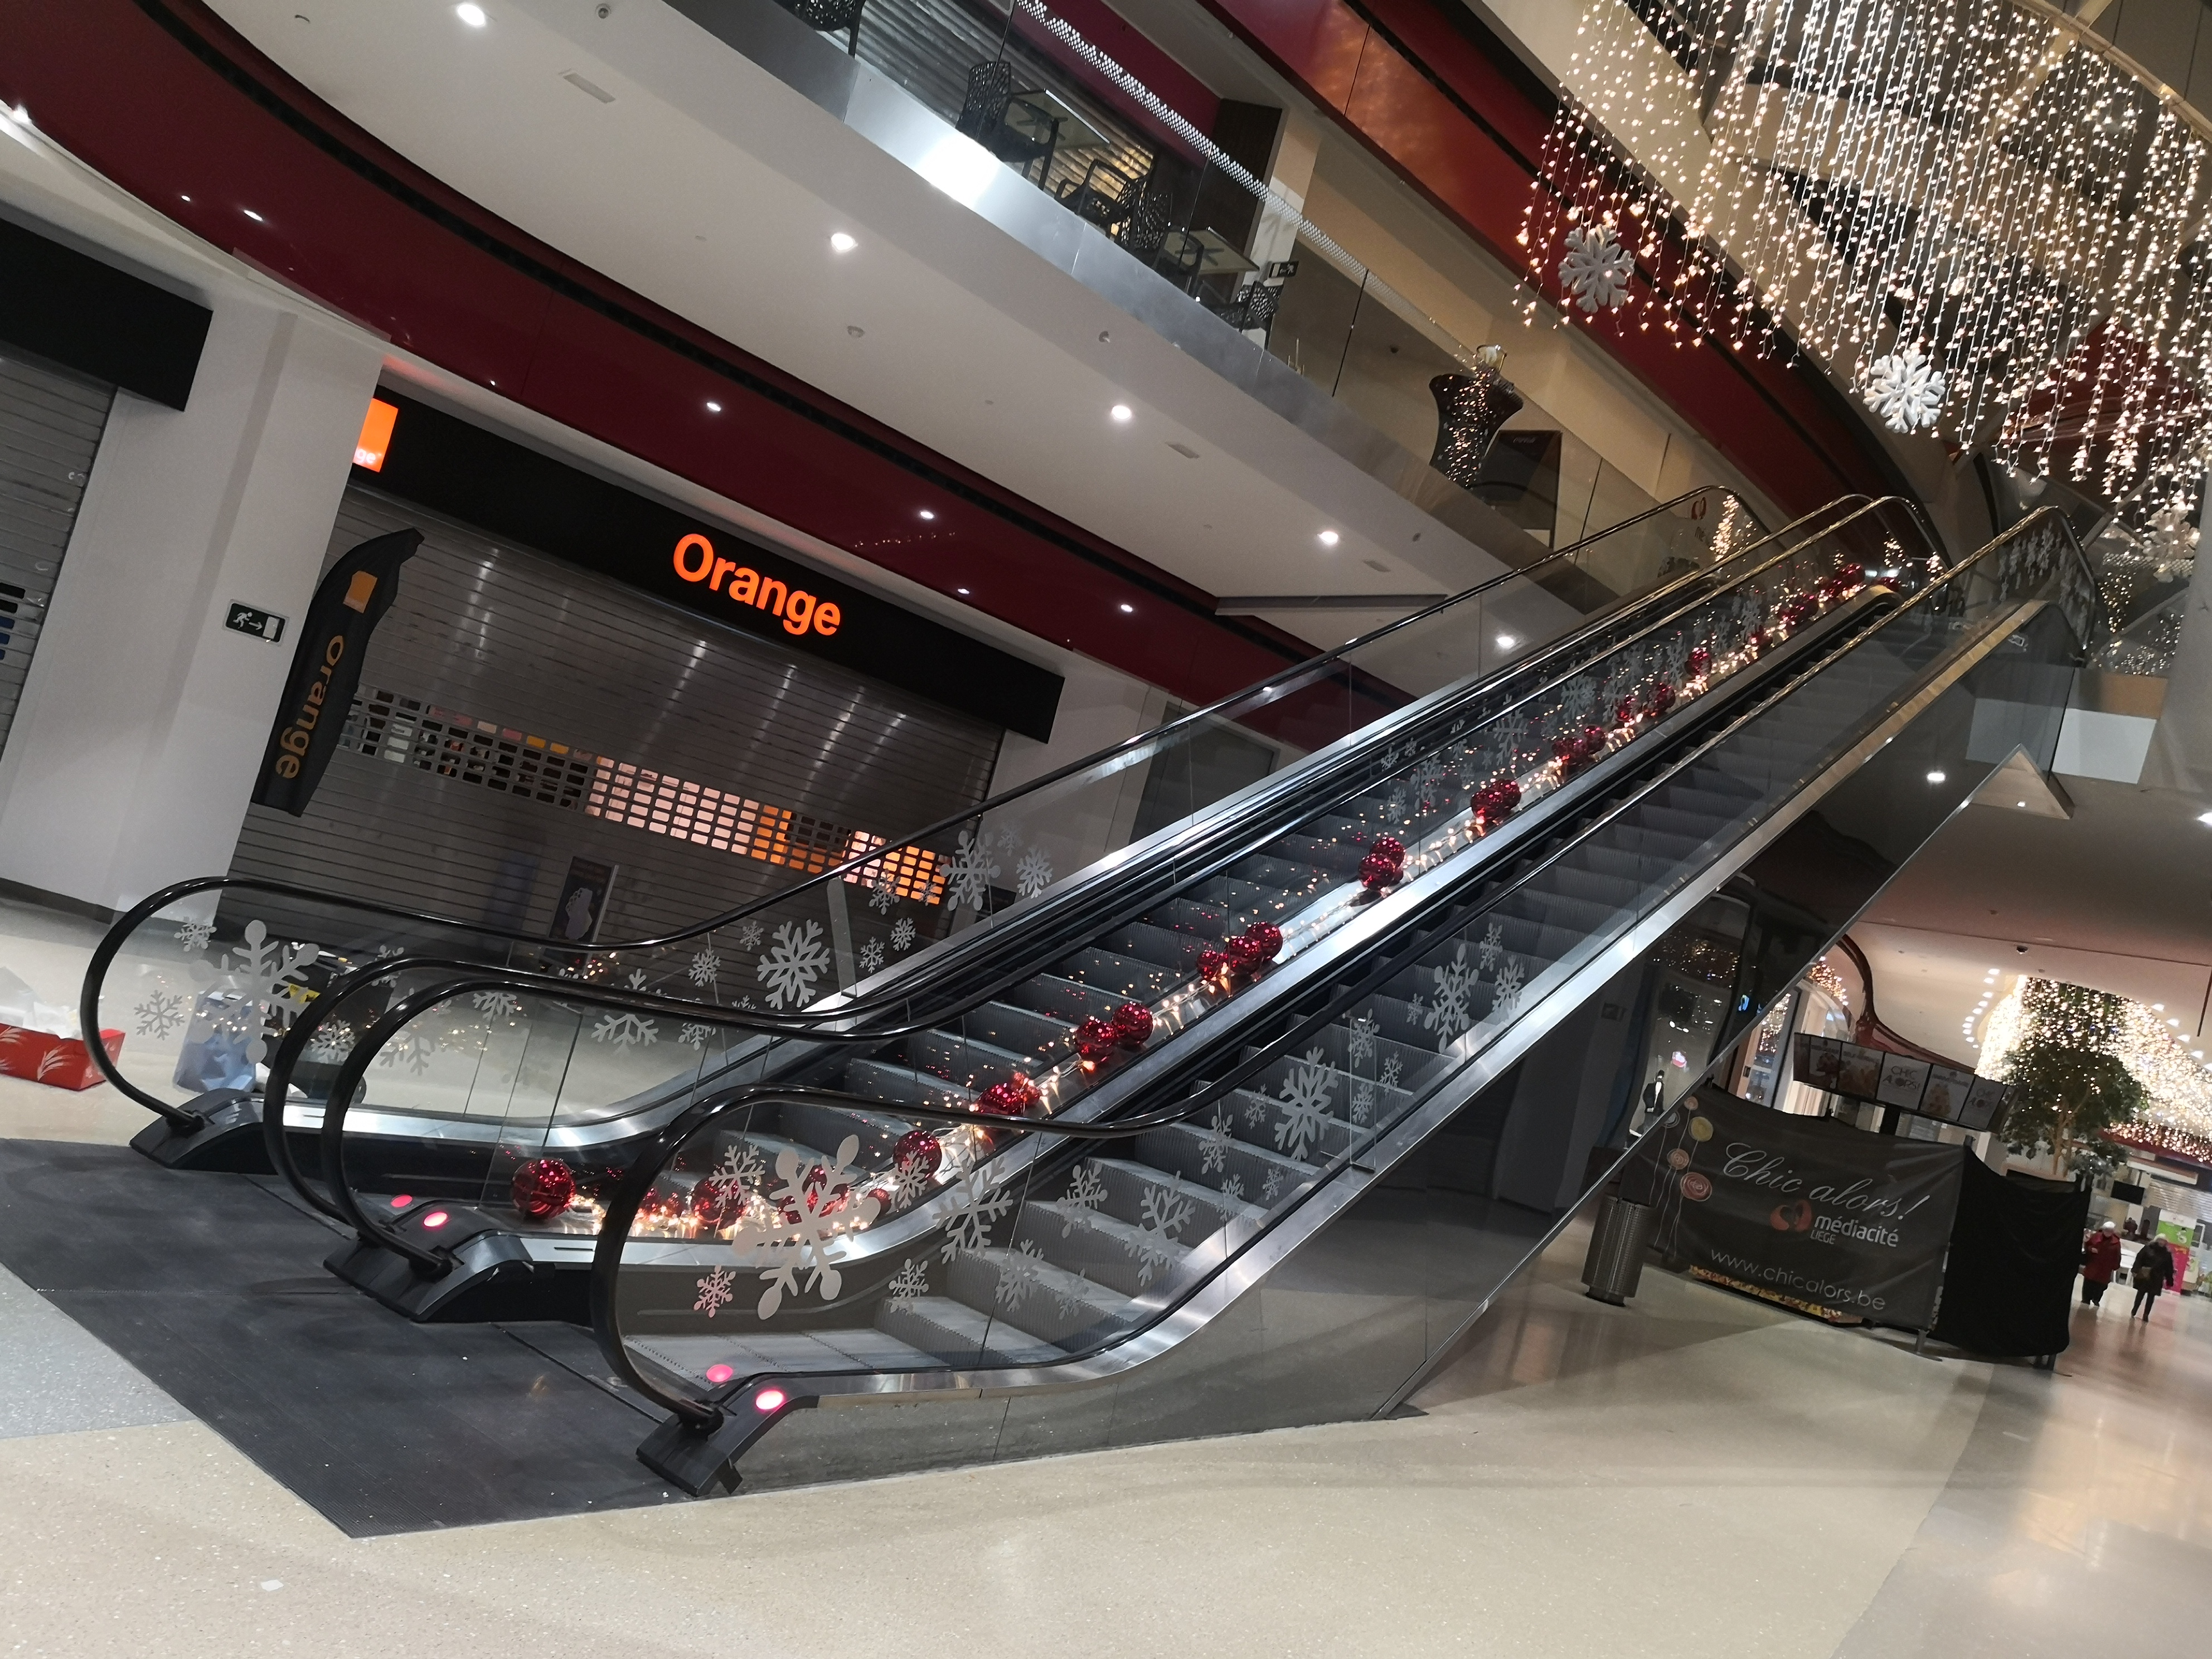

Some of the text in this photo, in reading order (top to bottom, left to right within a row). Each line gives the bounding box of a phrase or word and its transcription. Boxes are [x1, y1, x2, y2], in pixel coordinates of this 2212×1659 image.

[673, 533, 841, 636] Orange
[276, 635, 343, 779] orange
[1723, 1142, 1930, 1220] Chic alors!
[1810, 1229, 1836, 1245] LIEGE
[1814, 1215, 1899, 1247] médiacité
[1711, 1249, 1886, 1311] www.chicalors.be
